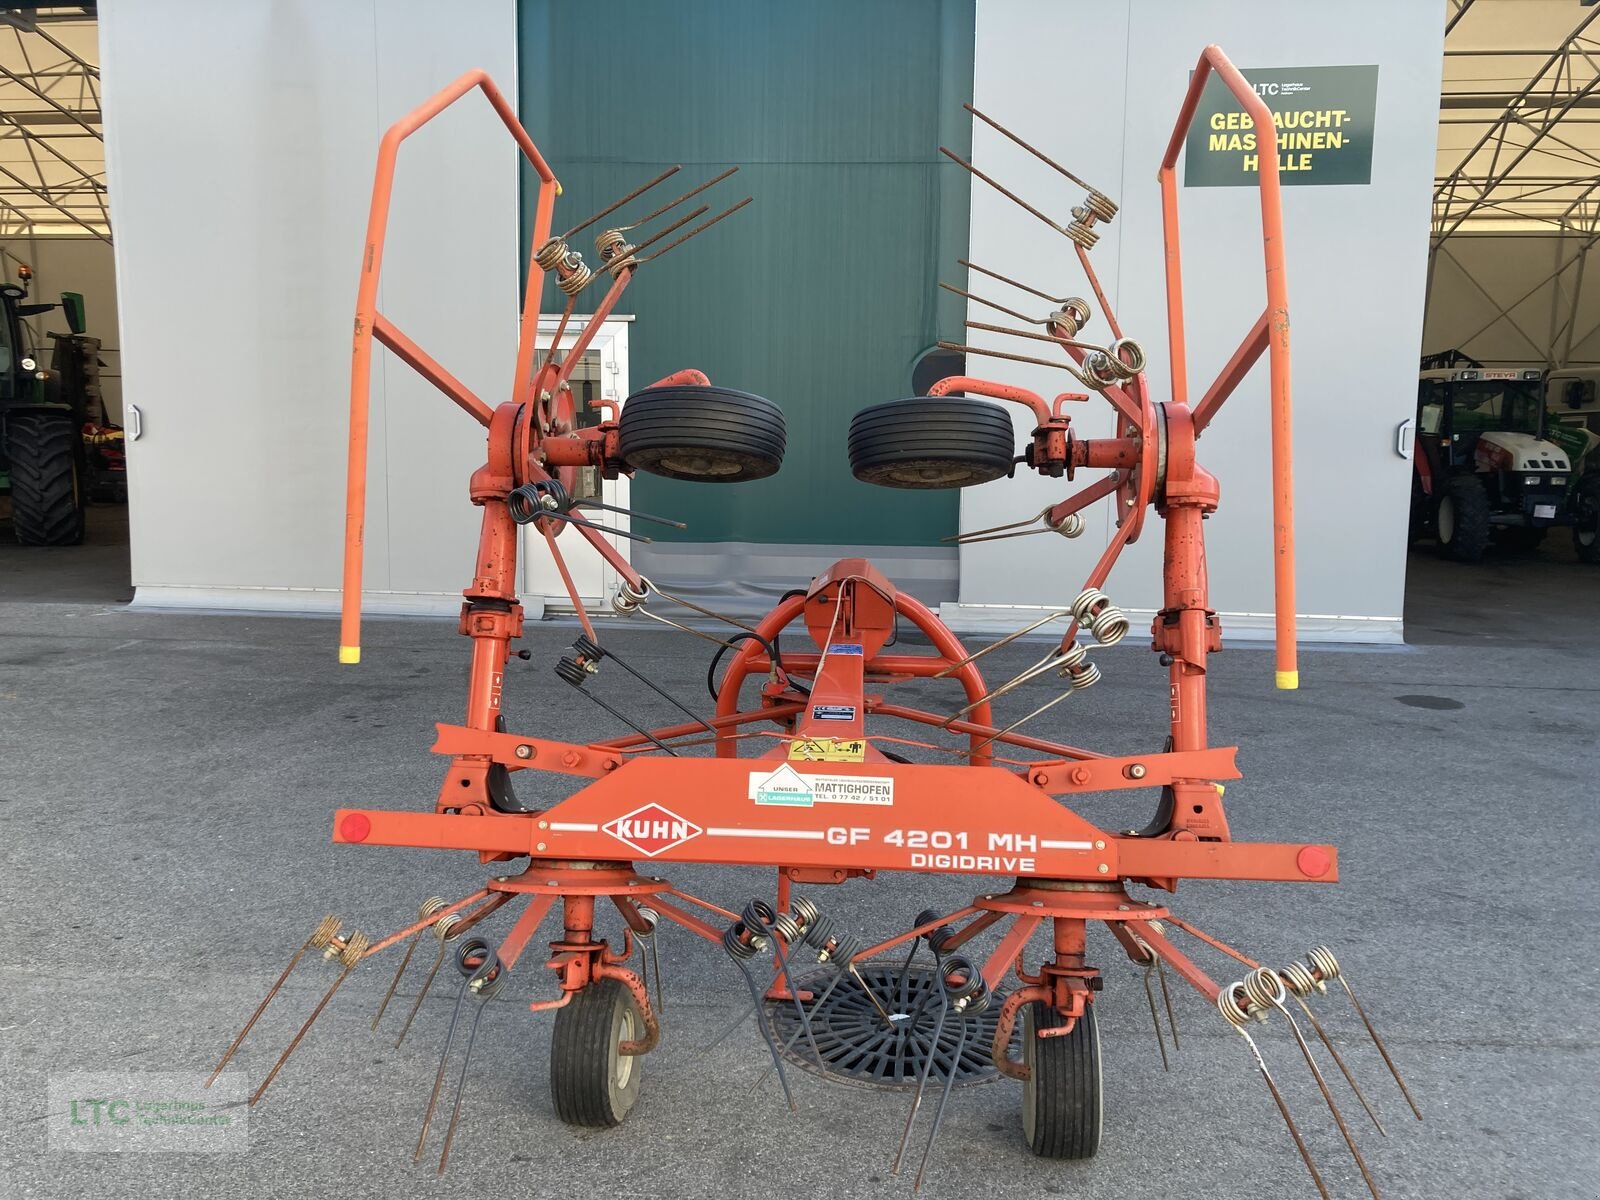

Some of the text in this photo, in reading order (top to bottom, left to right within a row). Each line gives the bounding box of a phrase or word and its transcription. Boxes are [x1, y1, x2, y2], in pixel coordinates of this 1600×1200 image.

[1253, 82, 1280, 96] LTC
[1210, 110, 1351, 130] GEBAUCHT-
[1209, 131, 1350, 151] MASHINEN-
[1243, 153, 1313, 172] HLLE
[815, 783, 890, 795] MATTIGHOFEN
[616, 820, 688, 840] KUHN
[827, 827, 1037, 852] GF 4201 MH
[911, 853, 1036, 872] DIGIDRIVE
